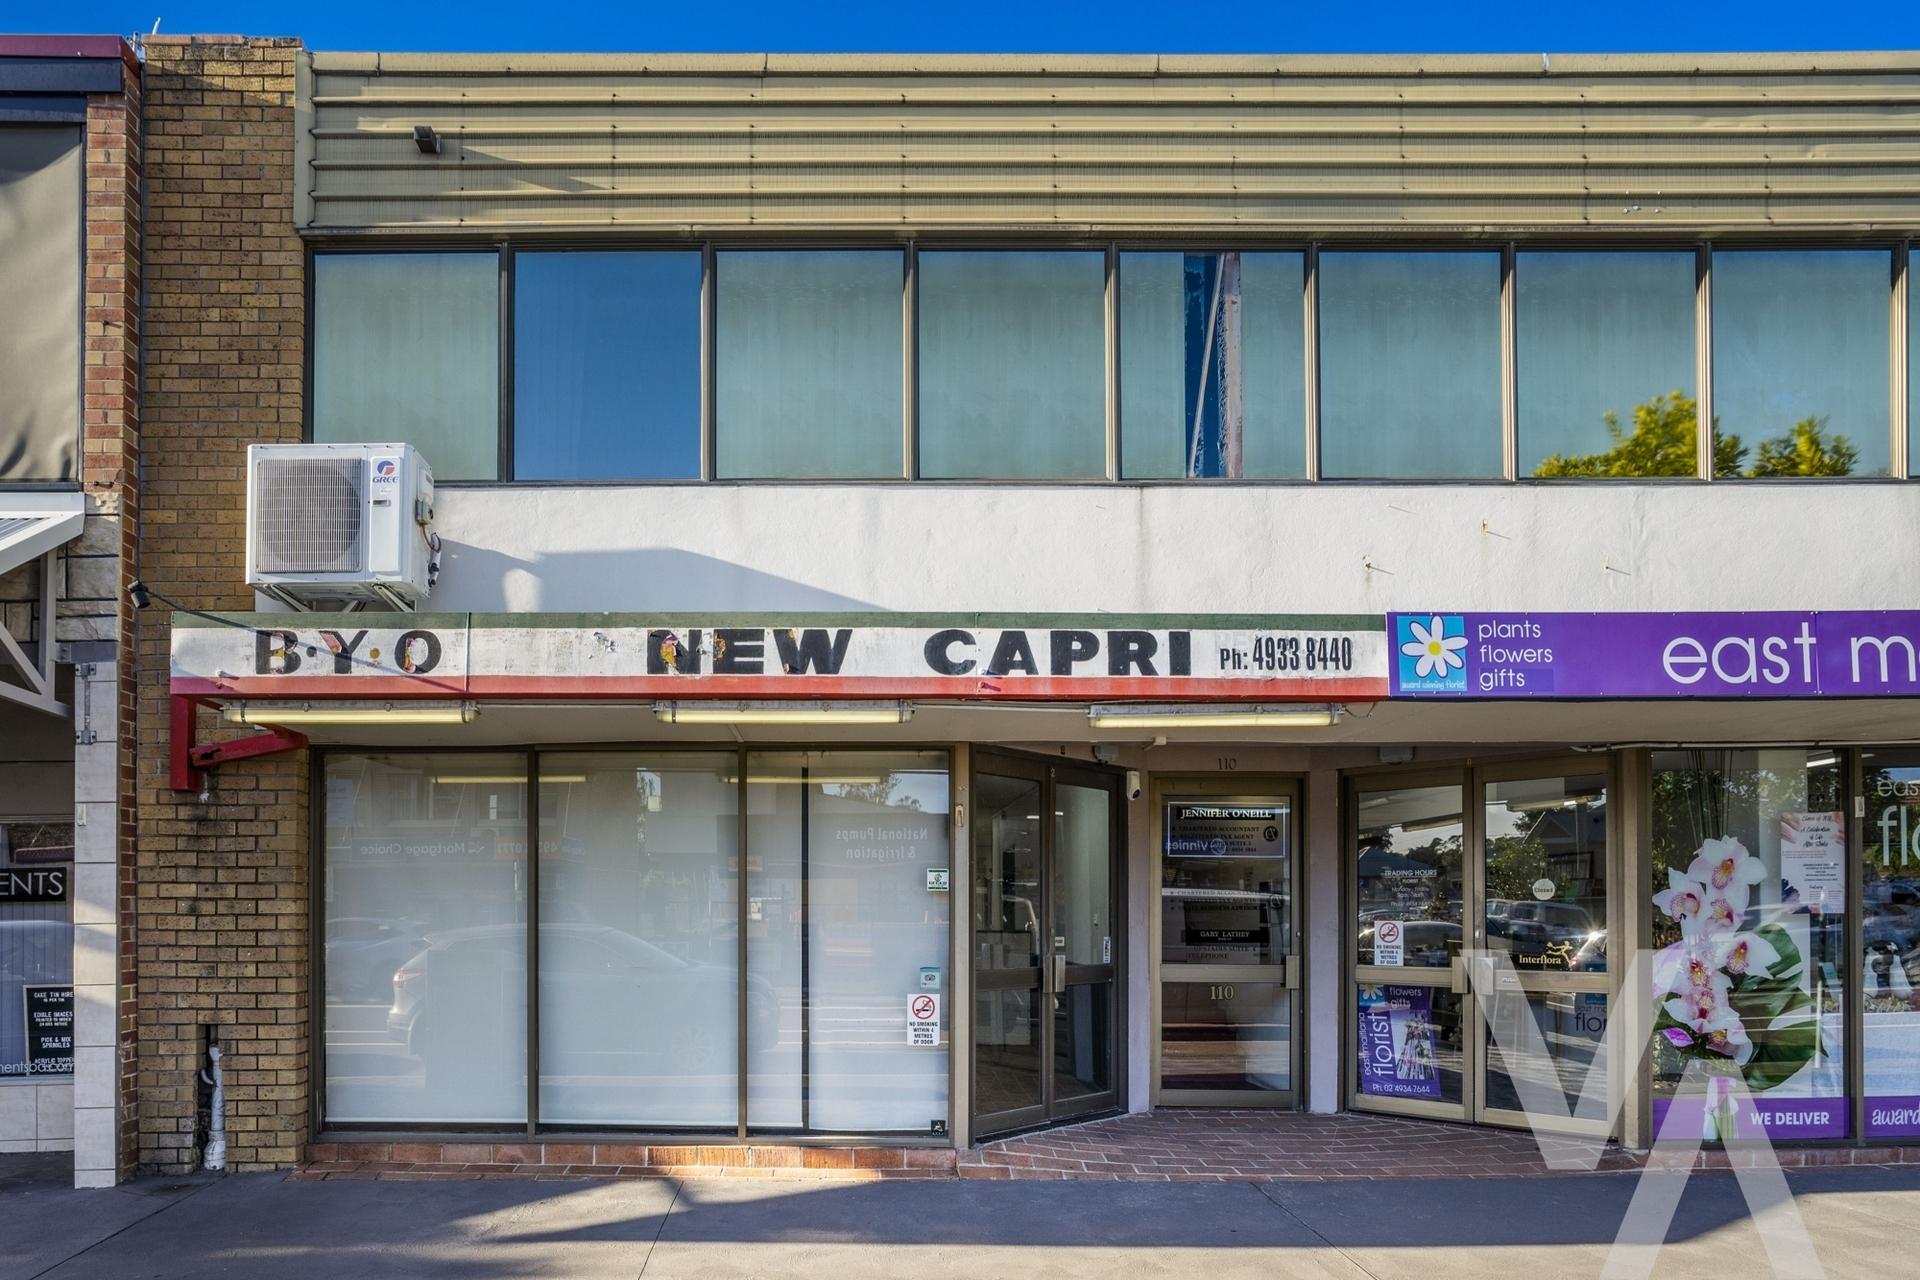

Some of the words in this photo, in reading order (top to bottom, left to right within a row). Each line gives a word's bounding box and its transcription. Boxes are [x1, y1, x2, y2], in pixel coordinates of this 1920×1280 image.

[1479, 620, 1541, 642] plants
[647, 629, 853, 675] NEW
[923, 629, 1191, 676] CAPRI
[1220, 647, 1248, 671] Ph:
[1252, 636, 1300, 671] 4933
[1306, 636, 1352, 671] 8440
[1480, 645, 1553, 663] flowers
[1662, 622, 1816, 684] east
[1850, 636, 1920, 683] m
[1480, 669, 1525, 691] gifts
[1218, 758, 1237, 770] 110
[1181, 809, 1229, 819] JENNIFER
[1232, 808, 1271, 818] O'NEILL
[1519, 954, 1562, 965] Interflora
[1210, 986, 1234, 1000] 110
[1390, 987, 1422, 997] flowers
[1391, 998, 1411, 1009] gifts
[1367, 1013, 1394, 1076] florist
[1384, 1084, 1393, 1092] 02
[1413, 1085, 1430, 1093] 7644
[1751, 1112, 1772, 1125] WE
[1775, 1112, 1830, 1125] DELIVER
